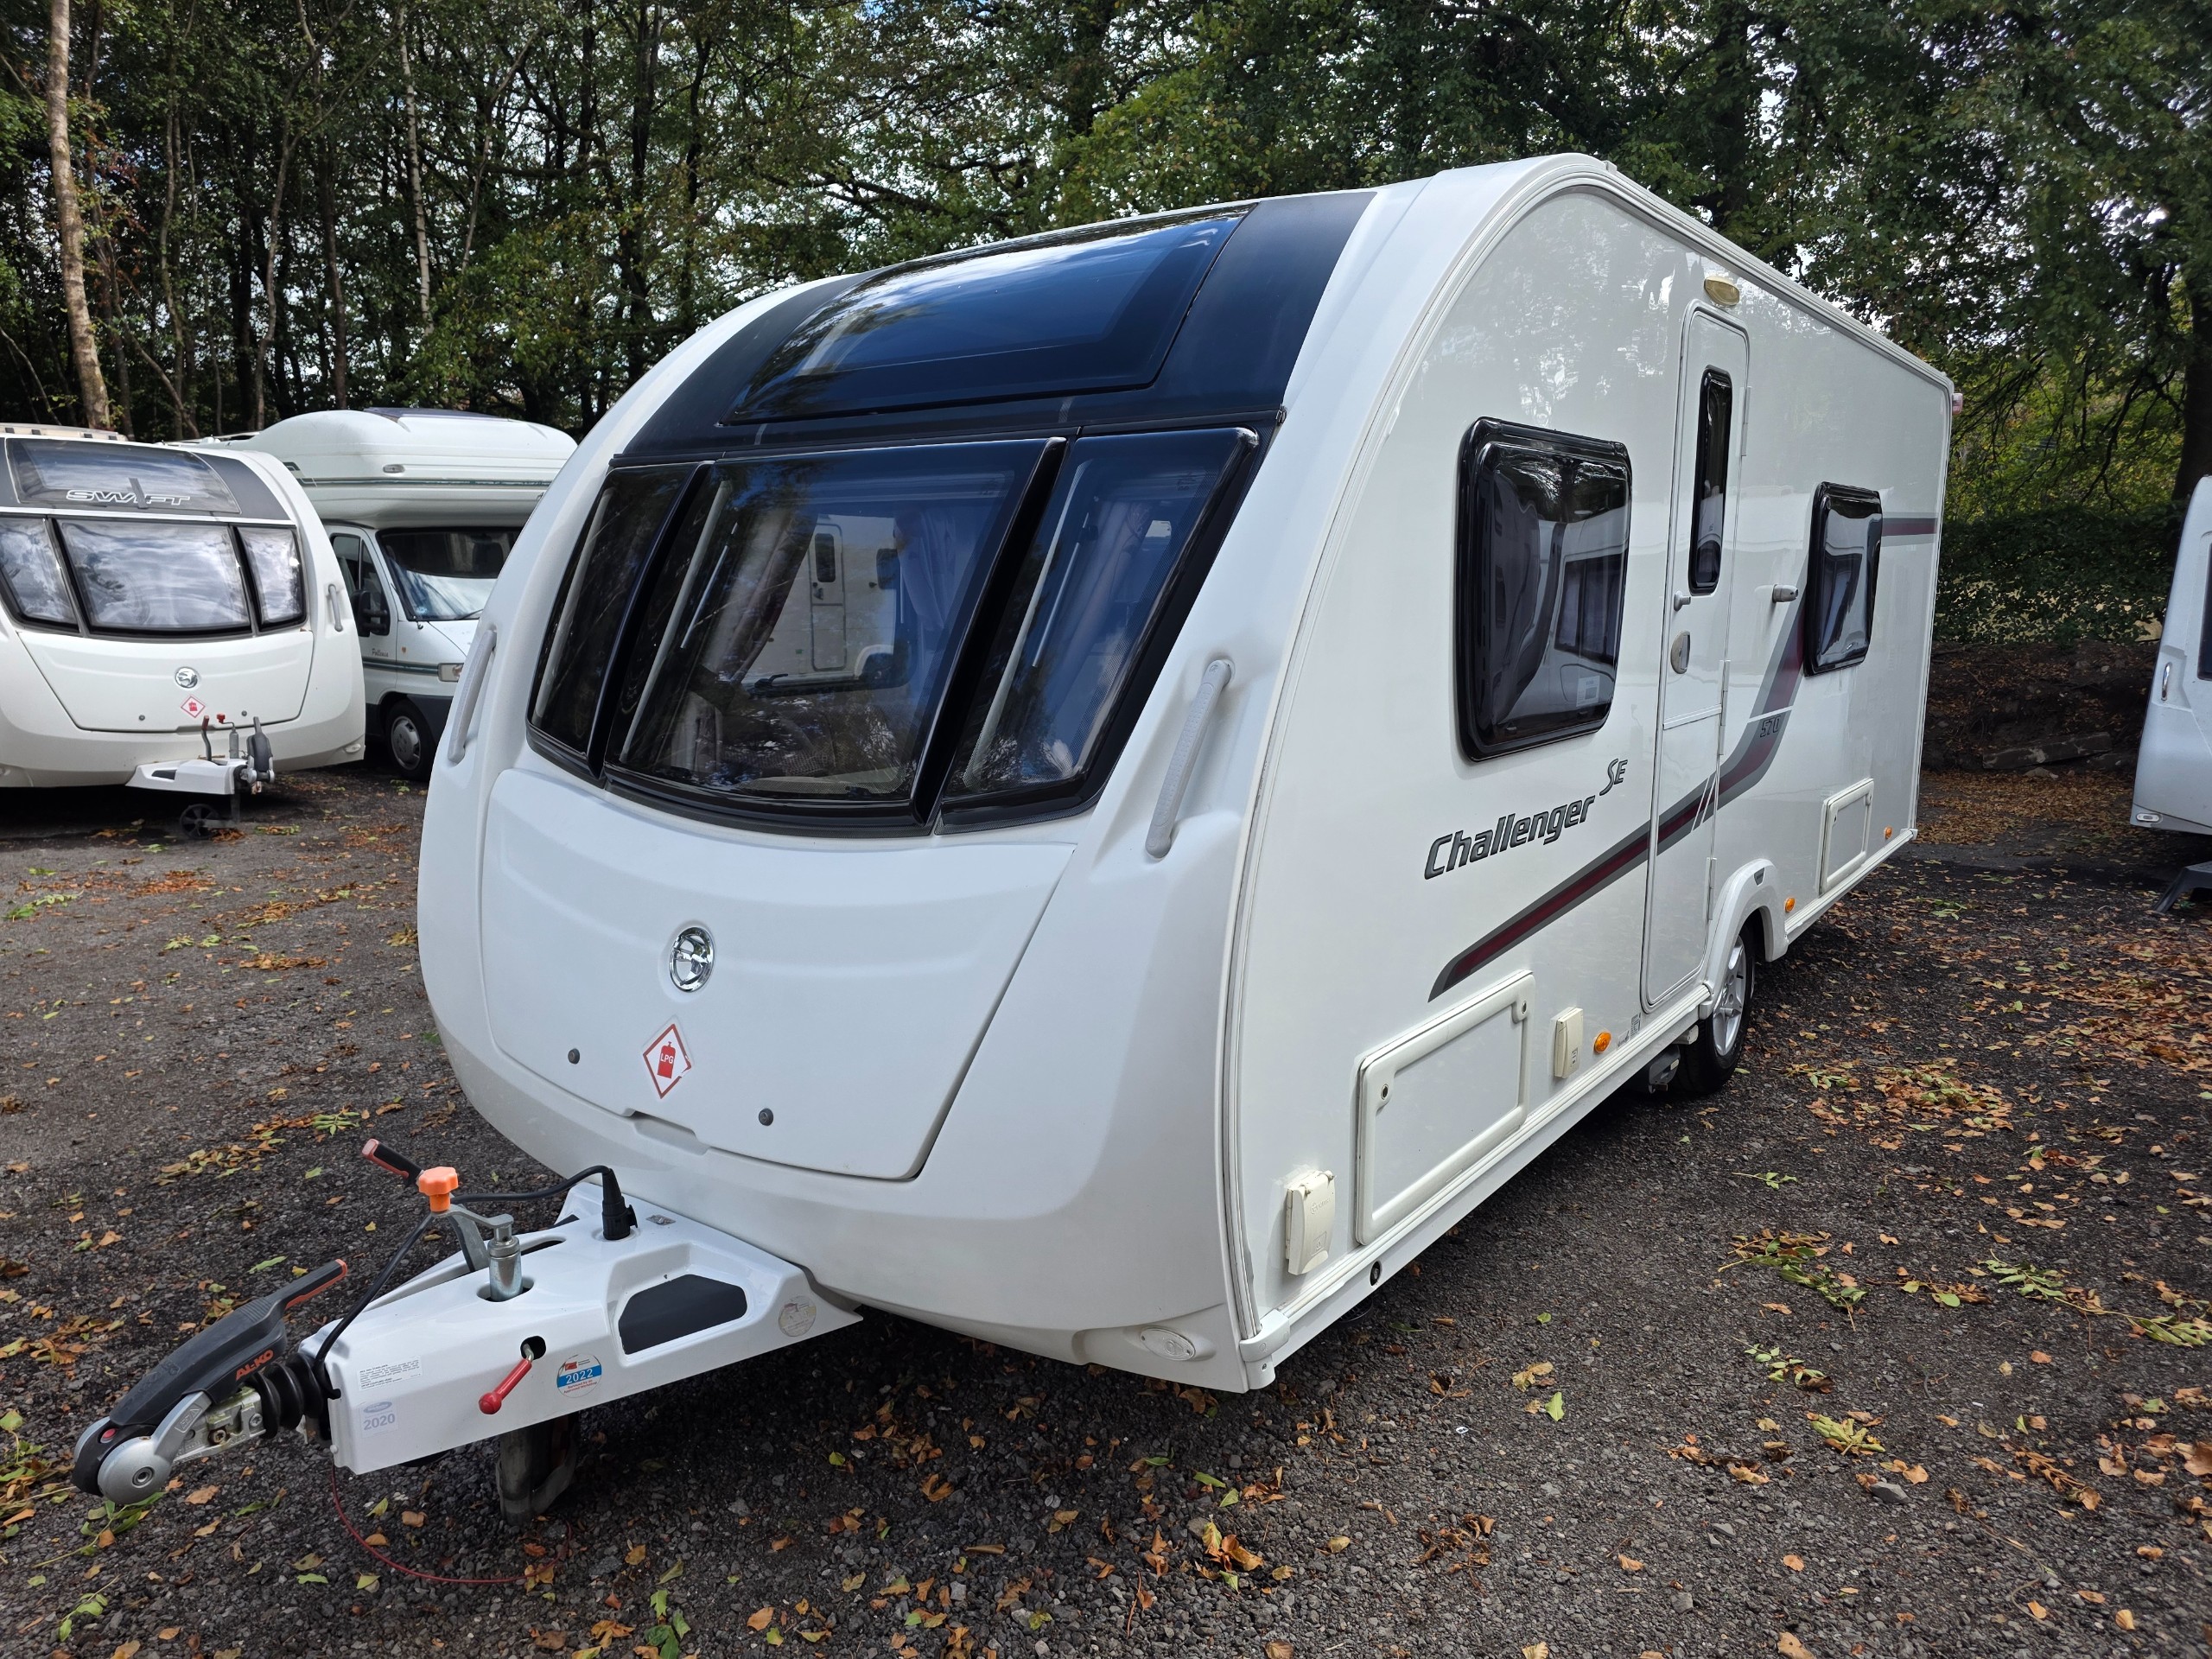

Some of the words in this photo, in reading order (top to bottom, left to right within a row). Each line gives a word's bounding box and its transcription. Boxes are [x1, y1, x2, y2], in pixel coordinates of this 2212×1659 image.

[1760, 715, 1782, 737] 570
[1424, 795, 1596, 880] Challenger
[1599, 758, 1628, 796] SE
[660, 1052, 674, 1064] LPG
[236, 1350, 274, 1381] AL-KO
[566, 1369, 594, 1384] 2022
[364, 1414, 395, 1430] 2020
